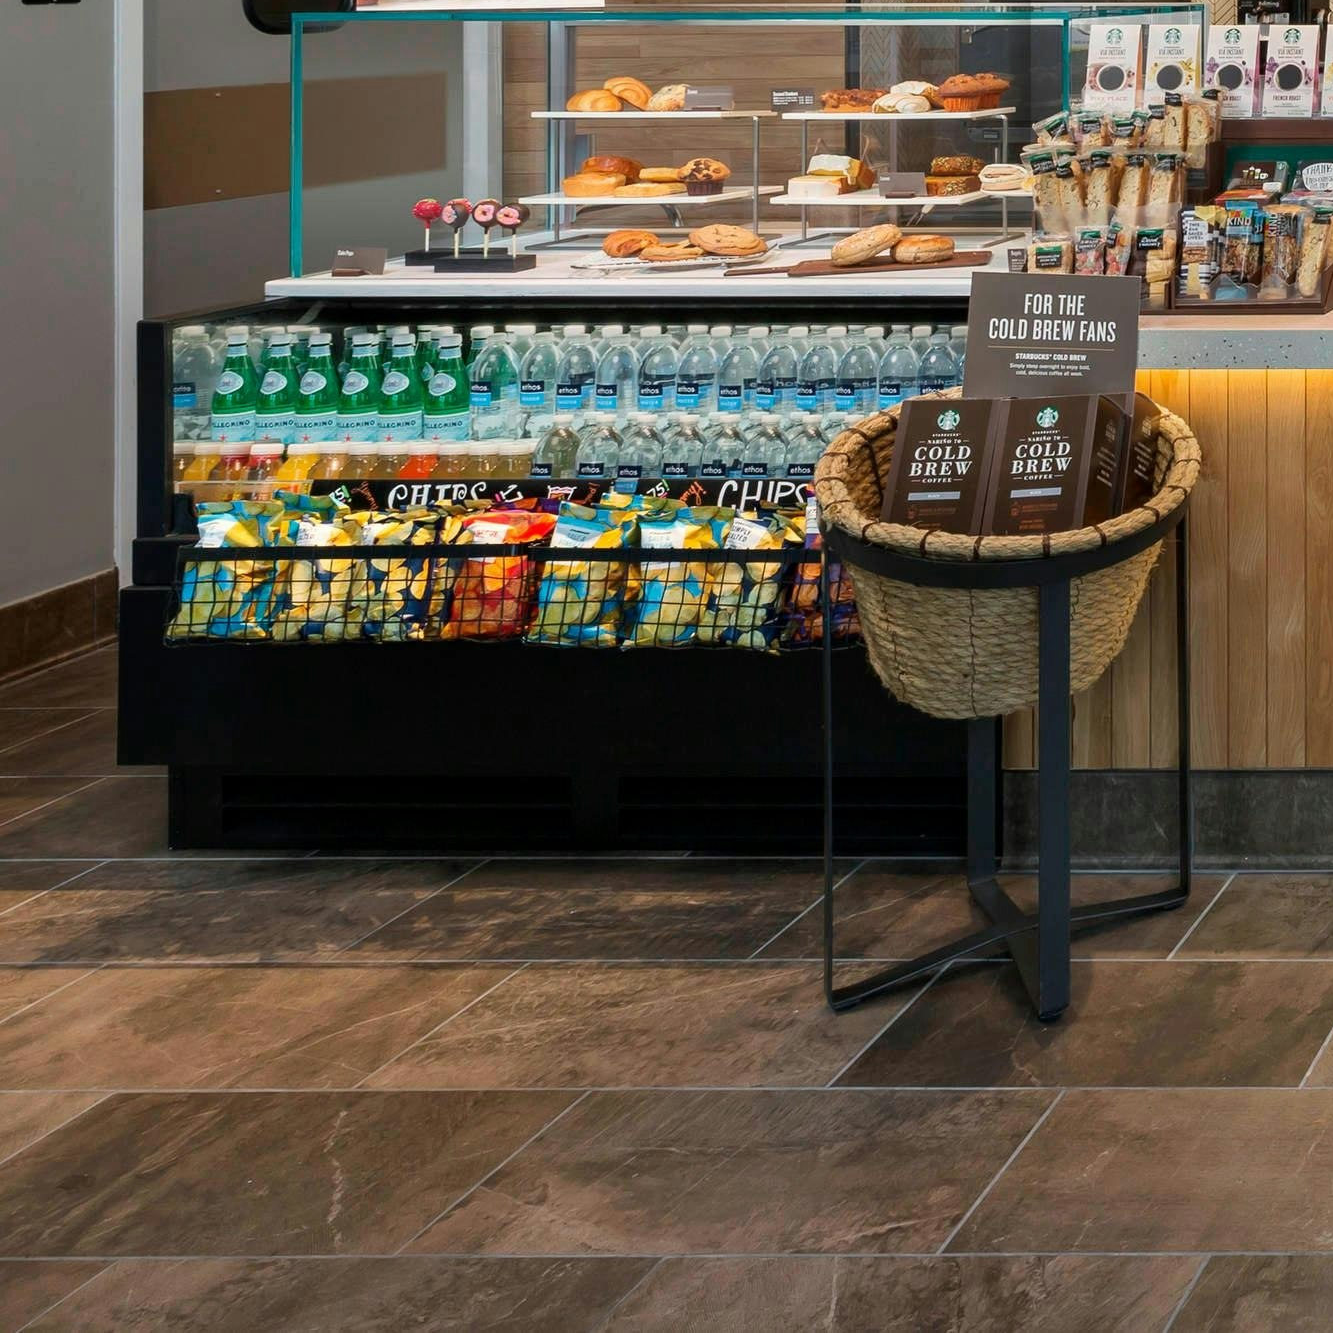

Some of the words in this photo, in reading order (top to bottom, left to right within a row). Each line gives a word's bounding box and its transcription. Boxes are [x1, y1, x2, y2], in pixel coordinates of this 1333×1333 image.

[1227, 218, 1251, 226] KIND
[1024, 294, 1053, 315] FOR
[1058, 295, 1086, 316] THE
[989, 318, 1028, 339] COLD
[1032, 319, 1075, 341] BREW
[1079, 321, 1116, 342] FANS
[522, 383, 541, 391] ethos
[640, 387, 659, 395] ethos
[881, 386, 897, 395] ethos
[720, 388, 738, 396] ethos
[914, 445, 971, 461] COLD
[1015, 442, 1071, 458] COLD
[581, 466, 600, 474] ethos
[703, 466, 722, 474] ethos
[908, 462, 972, 476] BREW
[1010, 457, 1072, 474] BREW
[620, 468, 637, 476] ethos
[387, 482, 487, 508] CHIPS
